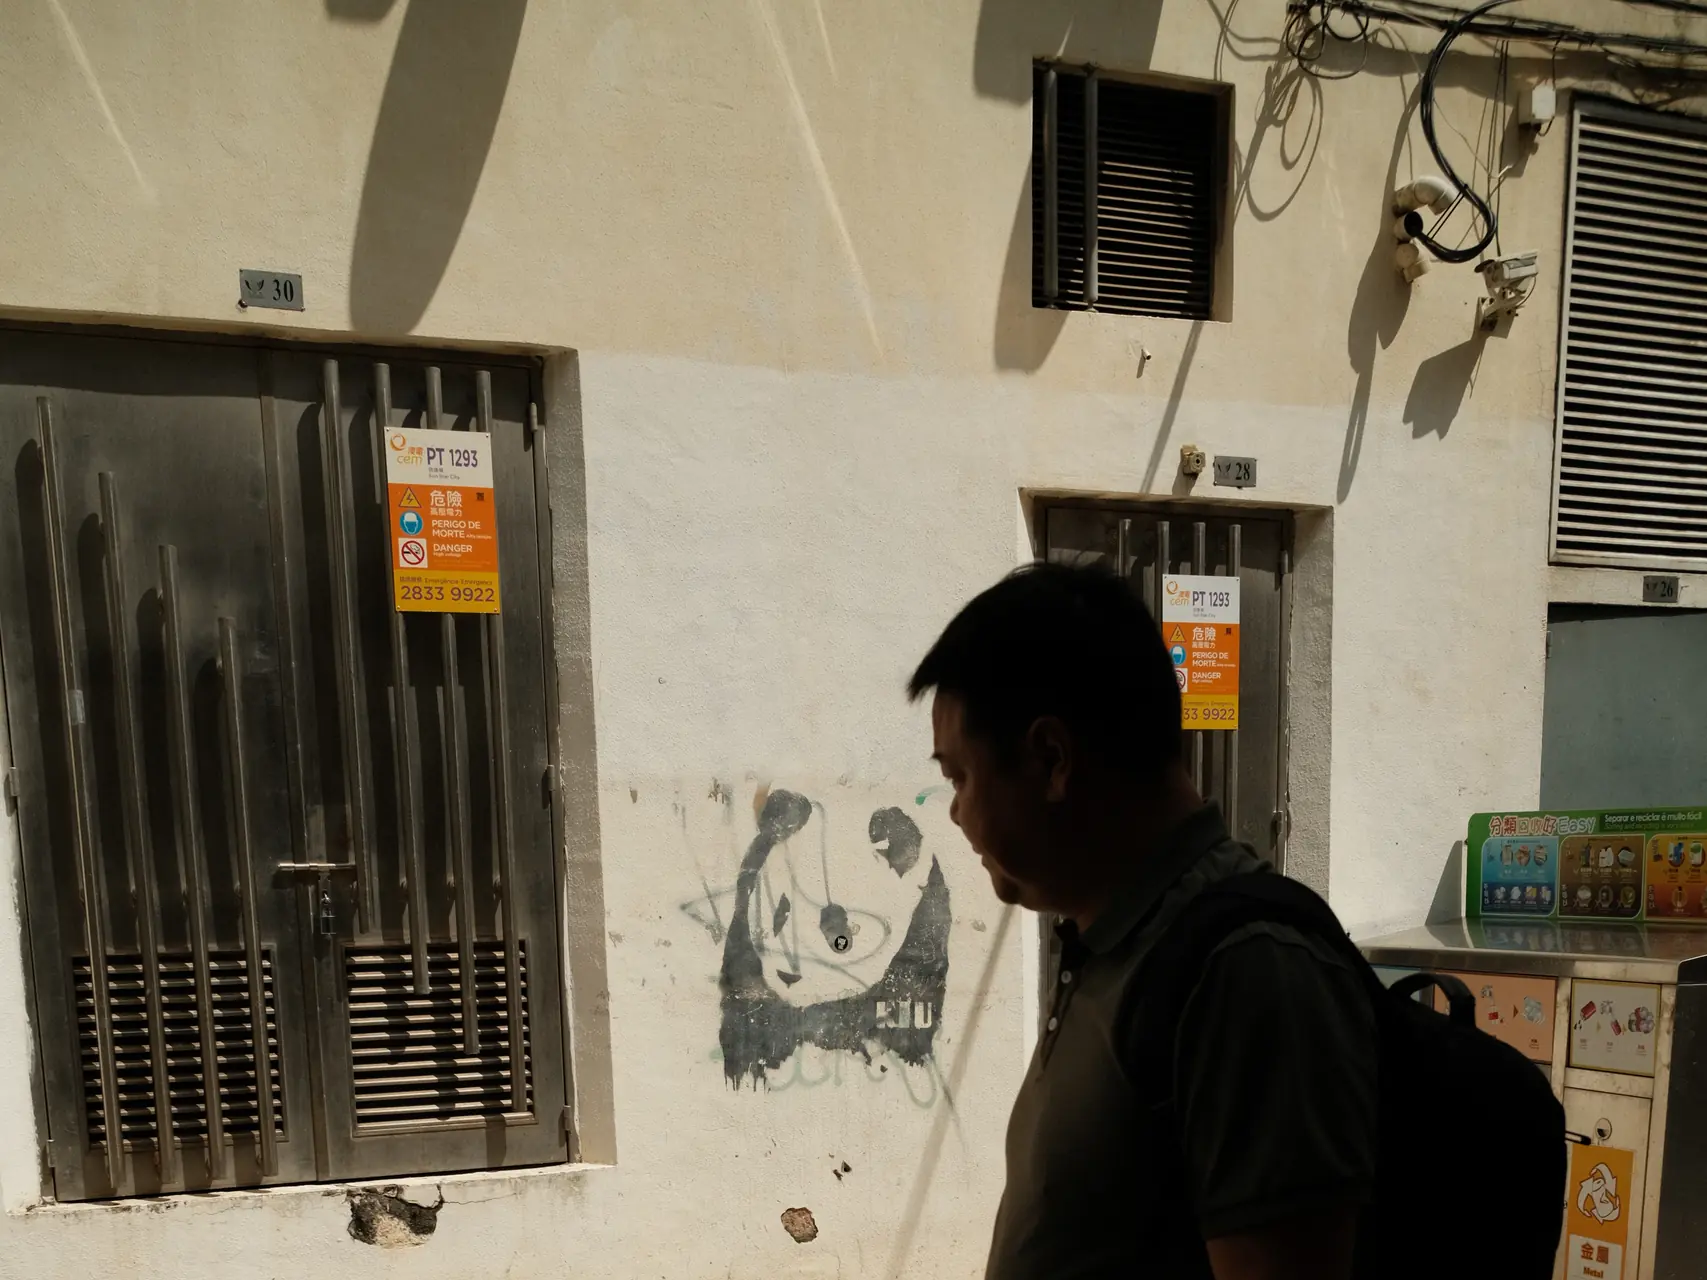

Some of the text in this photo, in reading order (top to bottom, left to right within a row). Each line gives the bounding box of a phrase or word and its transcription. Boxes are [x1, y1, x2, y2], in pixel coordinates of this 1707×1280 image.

[272, 278, 295, 303] 30
[426, 447, 479, 468] PT 1293
[1235, 462, 1251, 481] 28
[430, 489, 463, 508] 危險
[431, 519, 481, 530] PERIGO DE
[432, 529, 466, 539] MORTE
[433, 543, 473, 553] DANGER
[401, 585, 496, 603] 2833 9922
[1192, 590, 1230, 608] PT 1293
[1192, 626, 1217, 641] 危險
[1192, 652, 1229, 660] PERIGO DE
[1192, 660, 1217, 668] MORTE
[1192, 671, 1221, 680] DANGER
[1183, 707, 1236, 721] 33 9922
[1557, 816, 1596, 835] Easy
[1604, 814, 1630, 823] Separar
[1583, 1266, 1604, 1279] Metal
